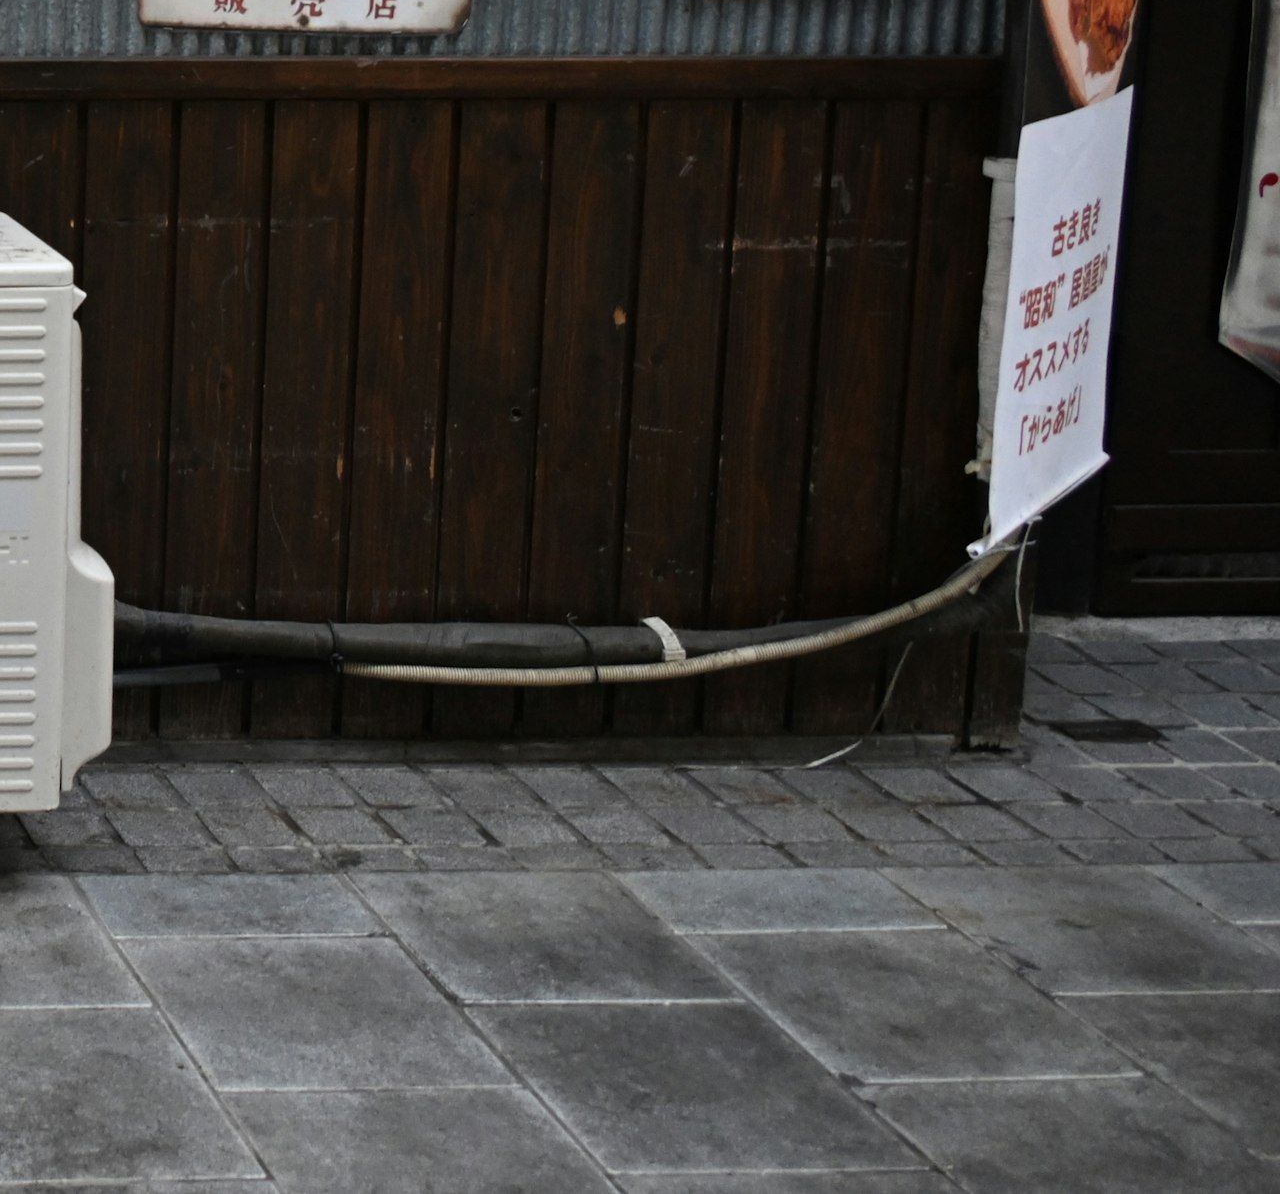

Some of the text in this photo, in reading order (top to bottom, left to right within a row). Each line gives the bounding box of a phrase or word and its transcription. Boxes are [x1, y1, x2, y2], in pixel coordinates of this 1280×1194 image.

[1051, 198, 1102, 257] 古き良き
[1013, 317, 1091, 393] オススメする
